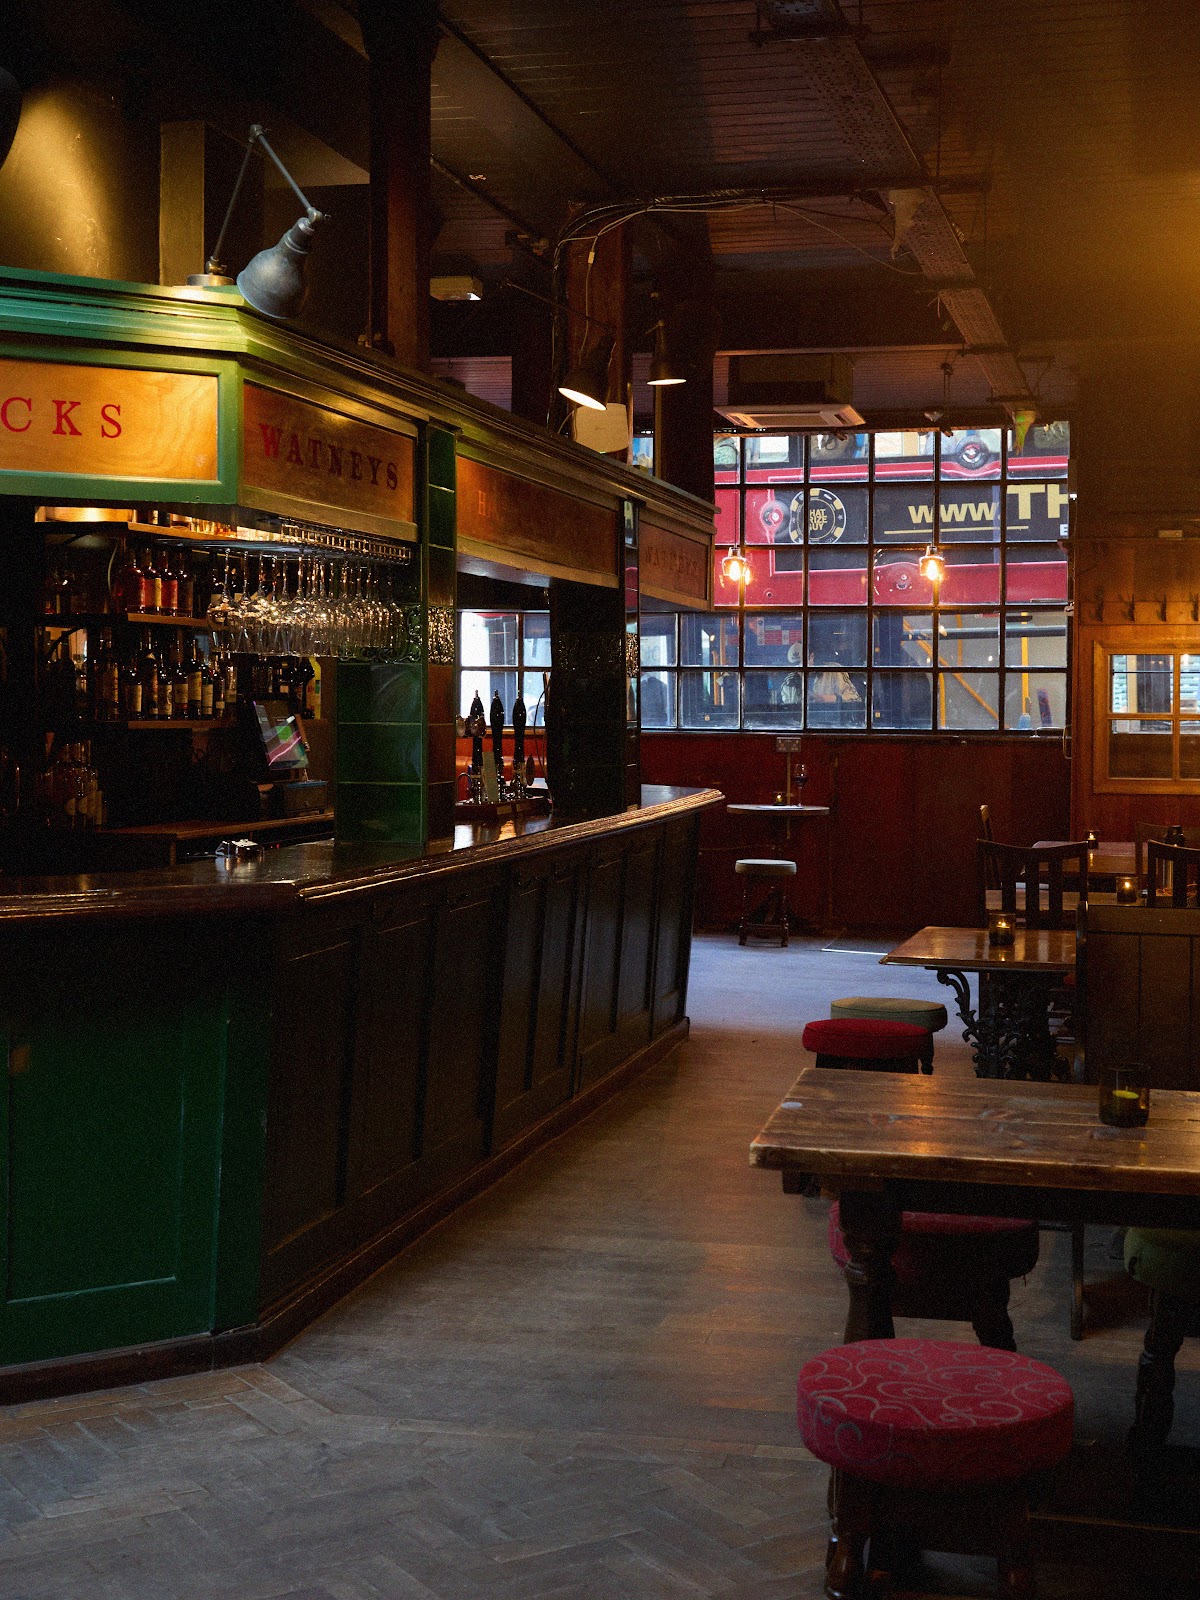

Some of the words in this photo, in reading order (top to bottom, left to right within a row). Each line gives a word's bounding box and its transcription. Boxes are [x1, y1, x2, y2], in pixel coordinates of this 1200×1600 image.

[258, 424, 399, 490] WATNEYS
[809, 509, 826, 517] HAT
[809, 516, 828, 524] RIZE
